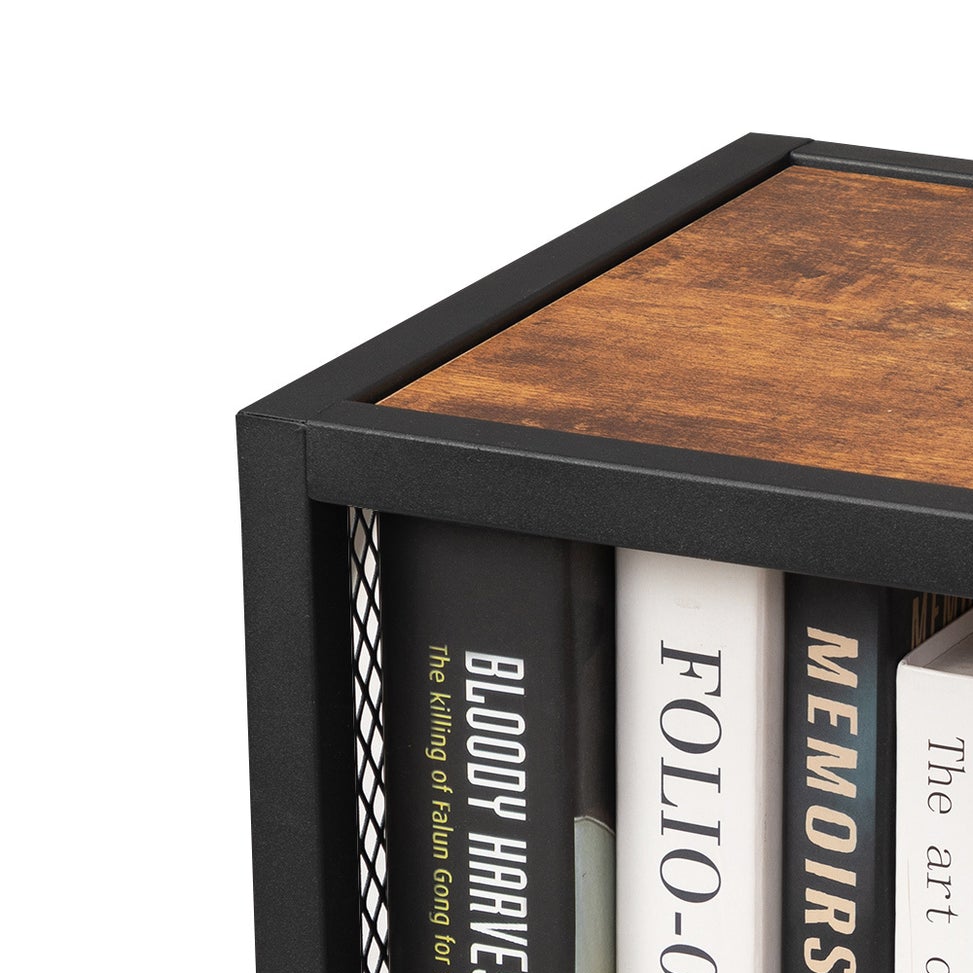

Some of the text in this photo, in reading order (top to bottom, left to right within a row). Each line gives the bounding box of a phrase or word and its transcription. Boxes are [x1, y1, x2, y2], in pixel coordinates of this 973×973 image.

[428, 644, 451, 683] The
[425, 690, 452, 762] killing
[465, 650, 527, 821] BLOODY
[431, 769, 453, 794] of
[926, 736, 966, 815] The
[432, 800, 454, 860] Falun
[429, 868, 453, 926] Gong
[925, 844, 959, 924] art
[434, 933, 456, 966] for
